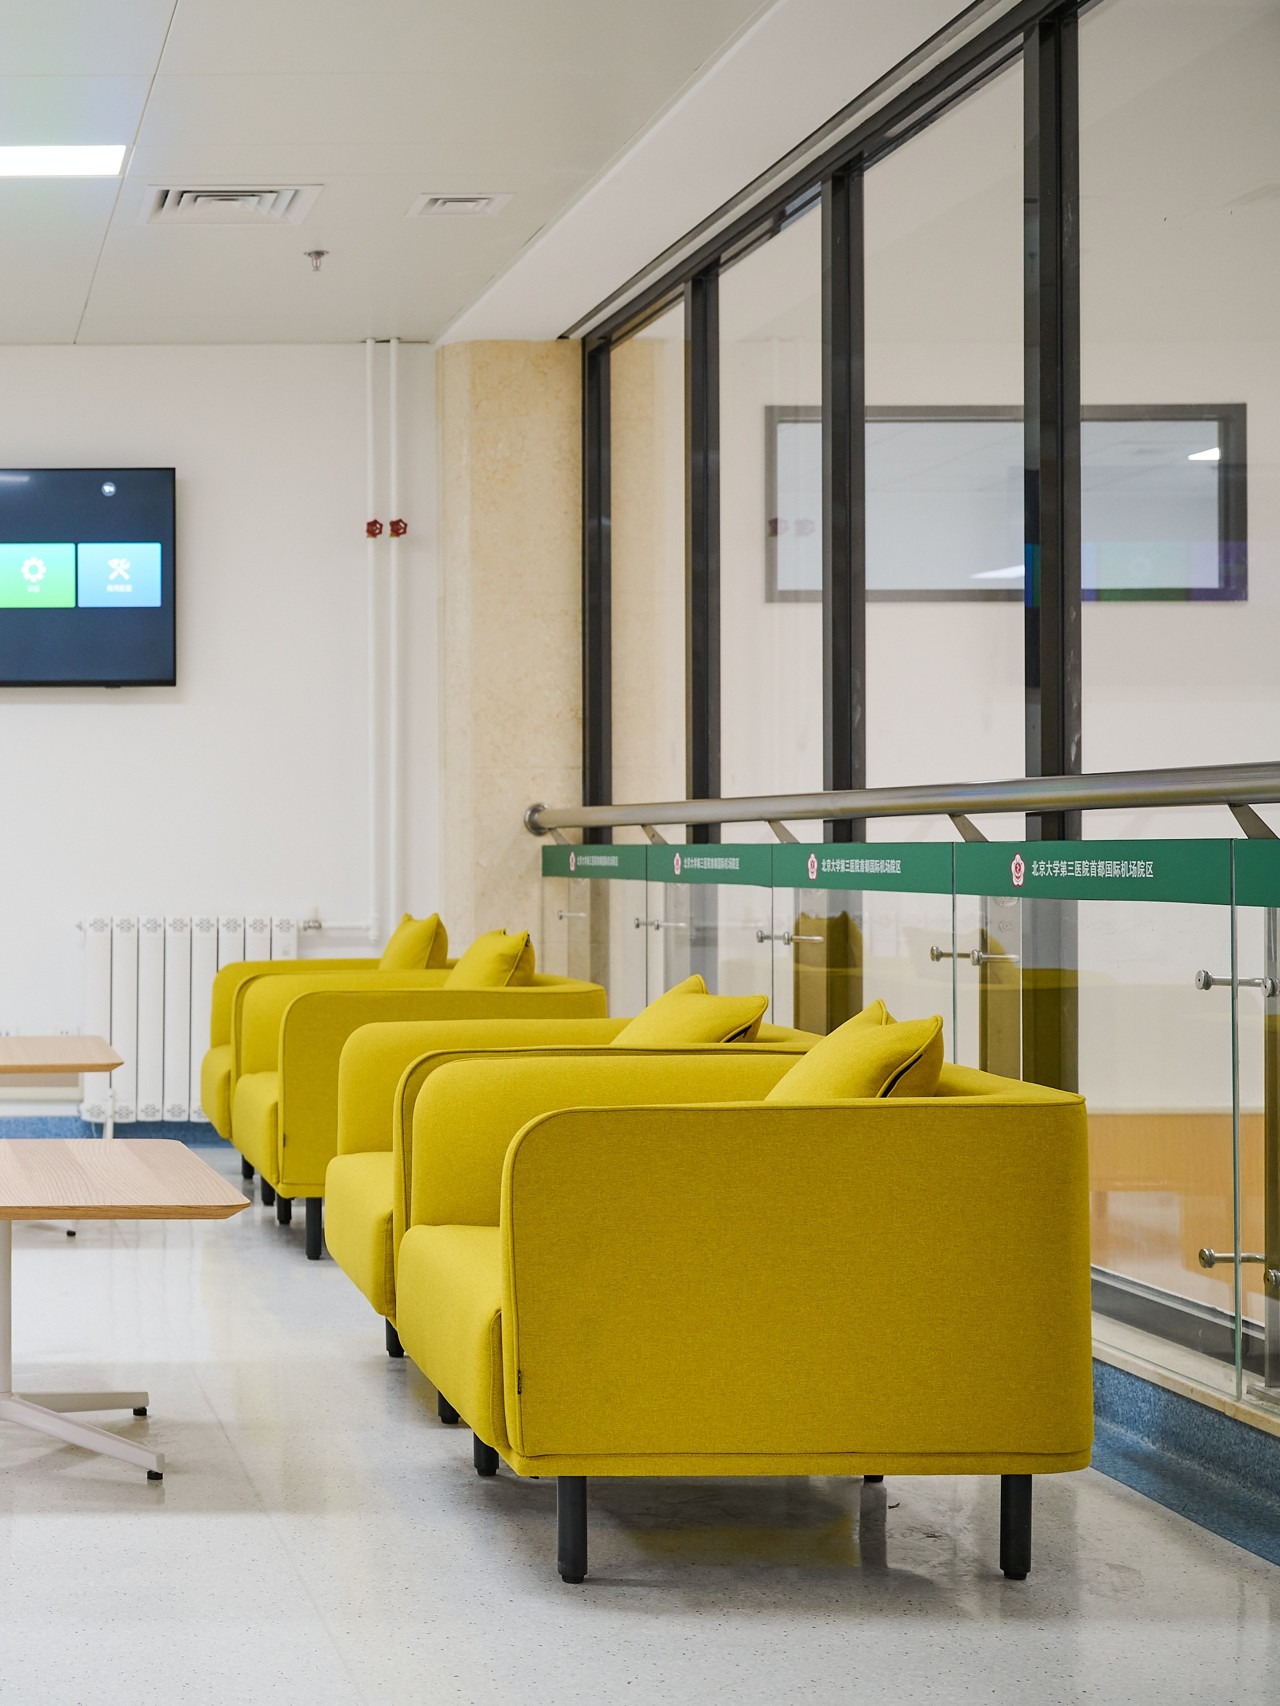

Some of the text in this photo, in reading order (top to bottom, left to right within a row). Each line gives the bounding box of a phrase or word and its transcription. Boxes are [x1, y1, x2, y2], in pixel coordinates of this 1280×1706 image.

[683, 857, 740, 870] 北京大学第三际机场院区
[1031, 860, 1154, 878] 北京大学第三医院首都国际机场院区
